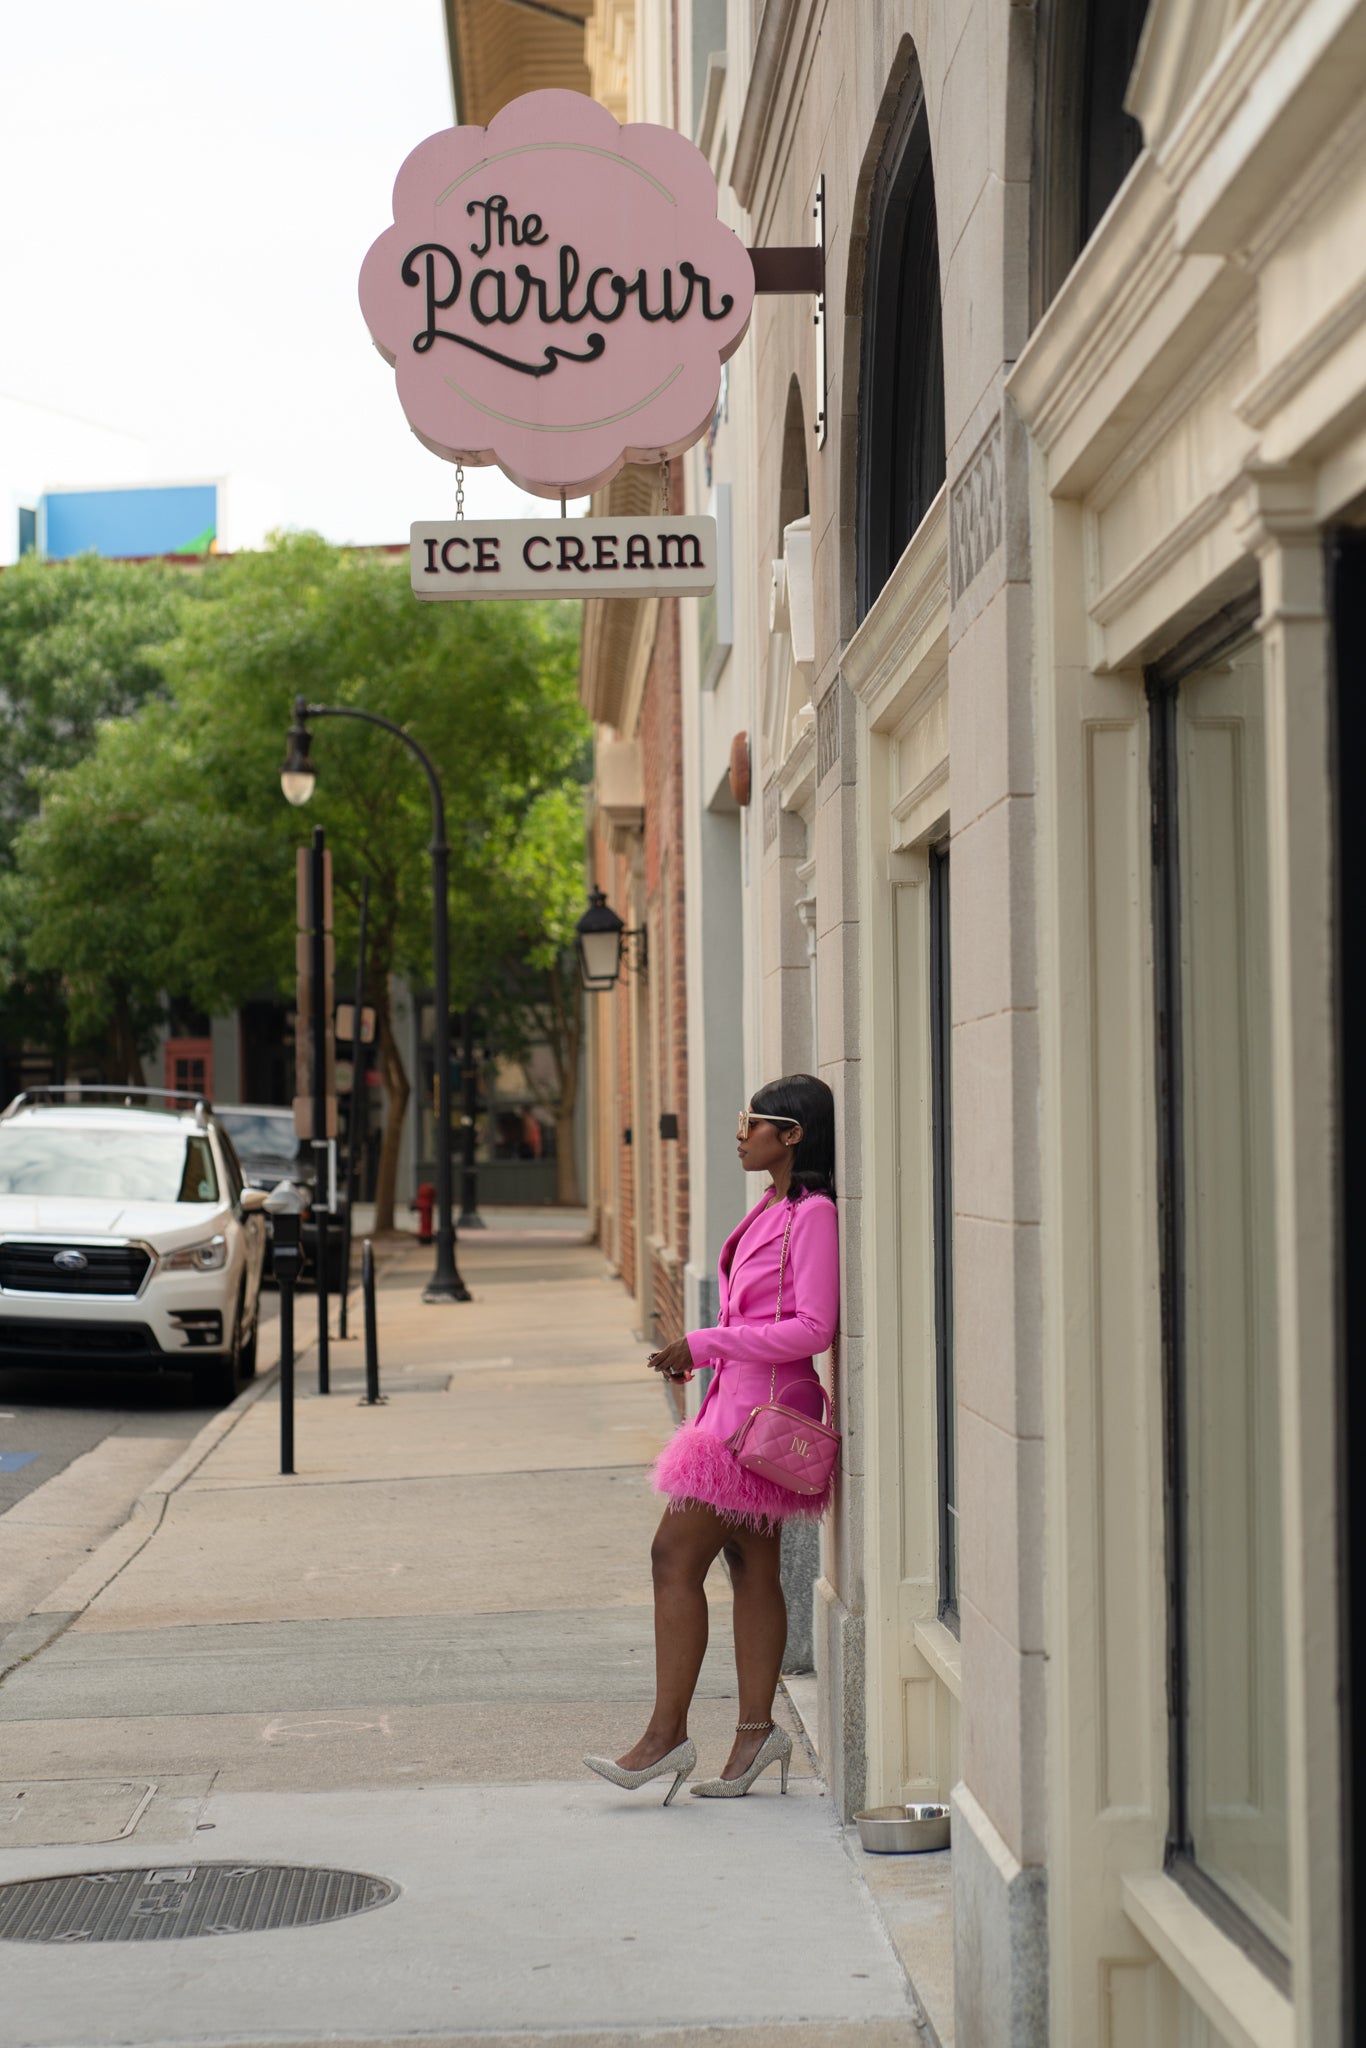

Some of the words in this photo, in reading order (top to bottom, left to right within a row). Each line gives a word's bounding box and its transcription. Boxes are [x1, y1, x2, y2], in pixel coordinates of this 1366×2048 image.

[466, 194, 549, 258] The
[401, 243, 734, 377] Parlour
[423, 537, 501, 574] ICE
